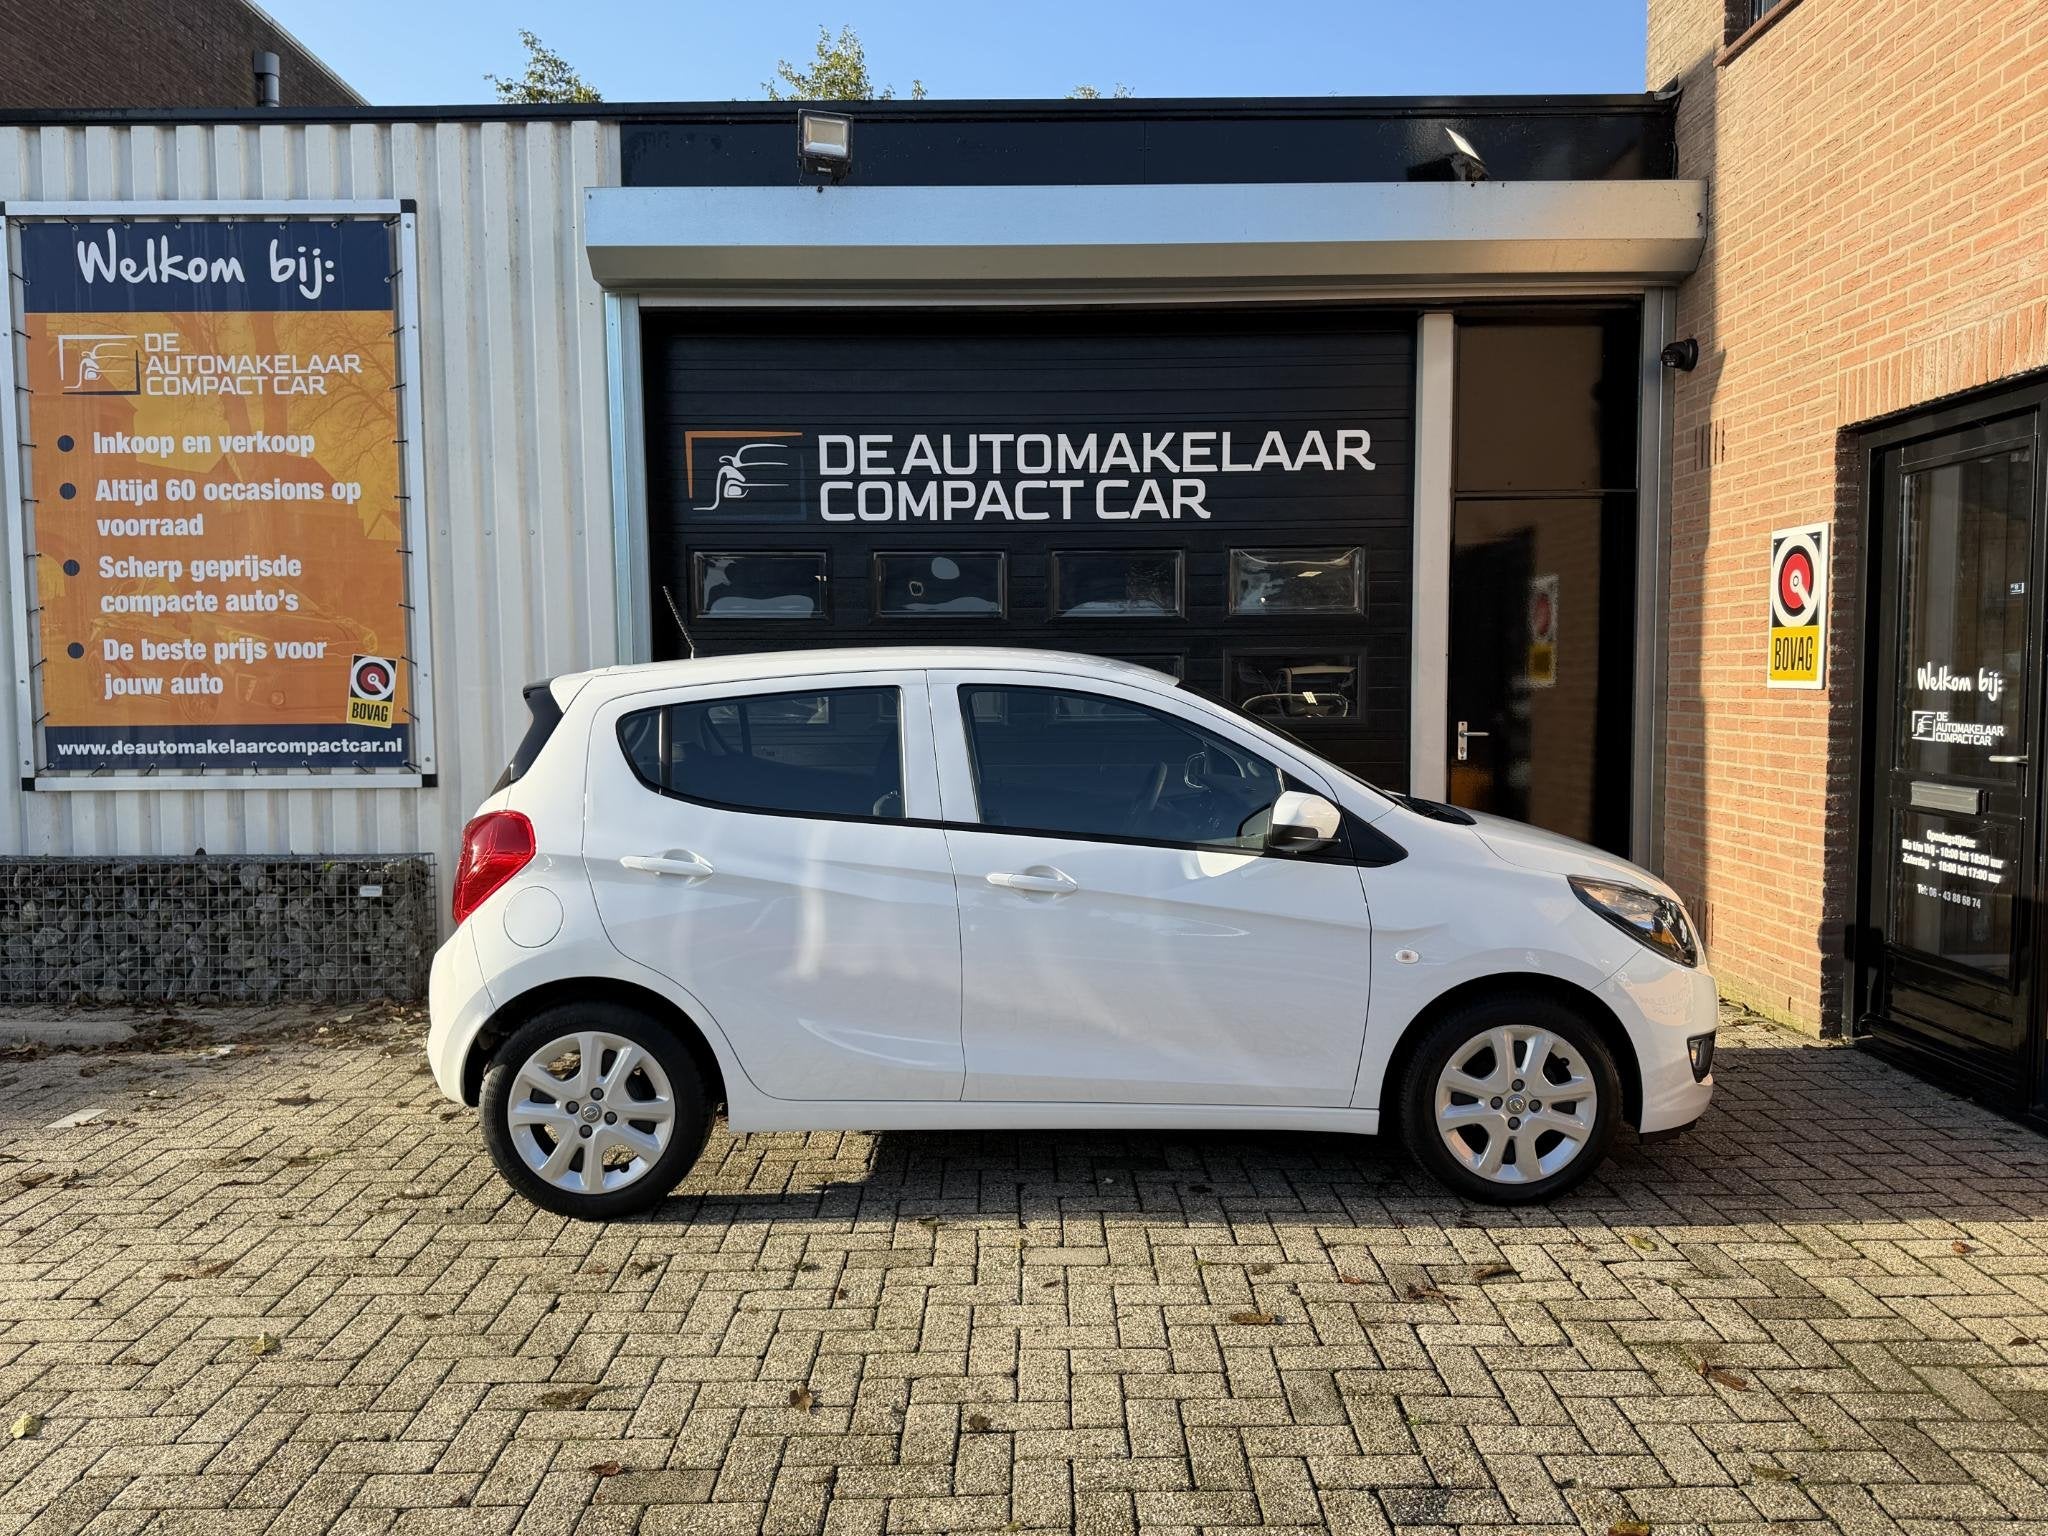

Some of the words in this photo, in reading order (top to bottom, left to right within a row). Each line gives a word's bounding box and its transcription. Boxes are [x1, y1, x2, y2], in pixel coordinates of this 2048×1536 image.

[77, 228, 245, 284] Welkom
[269, 238, 335, 300] bij:
[144, 332, 180, 353] DE
[145, 354, 362, 375] AUTOMAKELAAR
[146, 377, 268, 397] COMPACT
[273, 376, 327, 396] CAR
[93, 432, 175, 458] Inkoop
[182, 436, 211, 454] en
[219, 431, 315, 457] verkoop
[818, 433, 895, 477] DE
[900, 429, 1375, 477] AUTOMAKELAAR
[95, 479, 158, 506] Altijd
[165, 479, 196, 501] 60
[203, 479, 324, 501] occasions
[331, 483, 361, 505] op
[820, 479, 1084, 523] COMPACT
[1095, 478, 1211, 520] CAR
[96, 513, 204, 537] voorraad
[99, 556, 183, 582] Scherp
[190, 555, 302, 582] geprijsde
[100, 591, 218, 617] compacte
[226, 589, 299, 612] auto's
[103, 639, 133, 661] De
[141, 638, 206, 660] beste
[214, 637, 267, 664] prijs
[274, 641, 327, 660] voor
[1774, 635, 1813, 672] BOVAG
[104, 673, 163, 700] jouw
[170, 675, 224, 695] auto
[1917, 661, 1971, 691] Welkom
[1978, 667, 2003, 702] bij:
[352, 702, 389, 722] BOVAG
[1936, 711, 1949, 722] DE
[1936, 722, 2004, 737] AUTOMAKELAAR
[1936, 732, 1974, 744] COMPACT
[1974, 735, 1992, 746] CAR
[57, 738, 403, 757] www.deautomakelaarcompactcar.nl
[1959, 850, 1970, 862] tot
[1957, 864, 1968, 876] tot
[1929, 886, 1937, 898] 06
[1942, 890, 1951, 902] 43
[1952, 892, 1961, 904] 88
[1961, 895, 1971, 907] 68
[1972, 897, 1981, 909] 74
